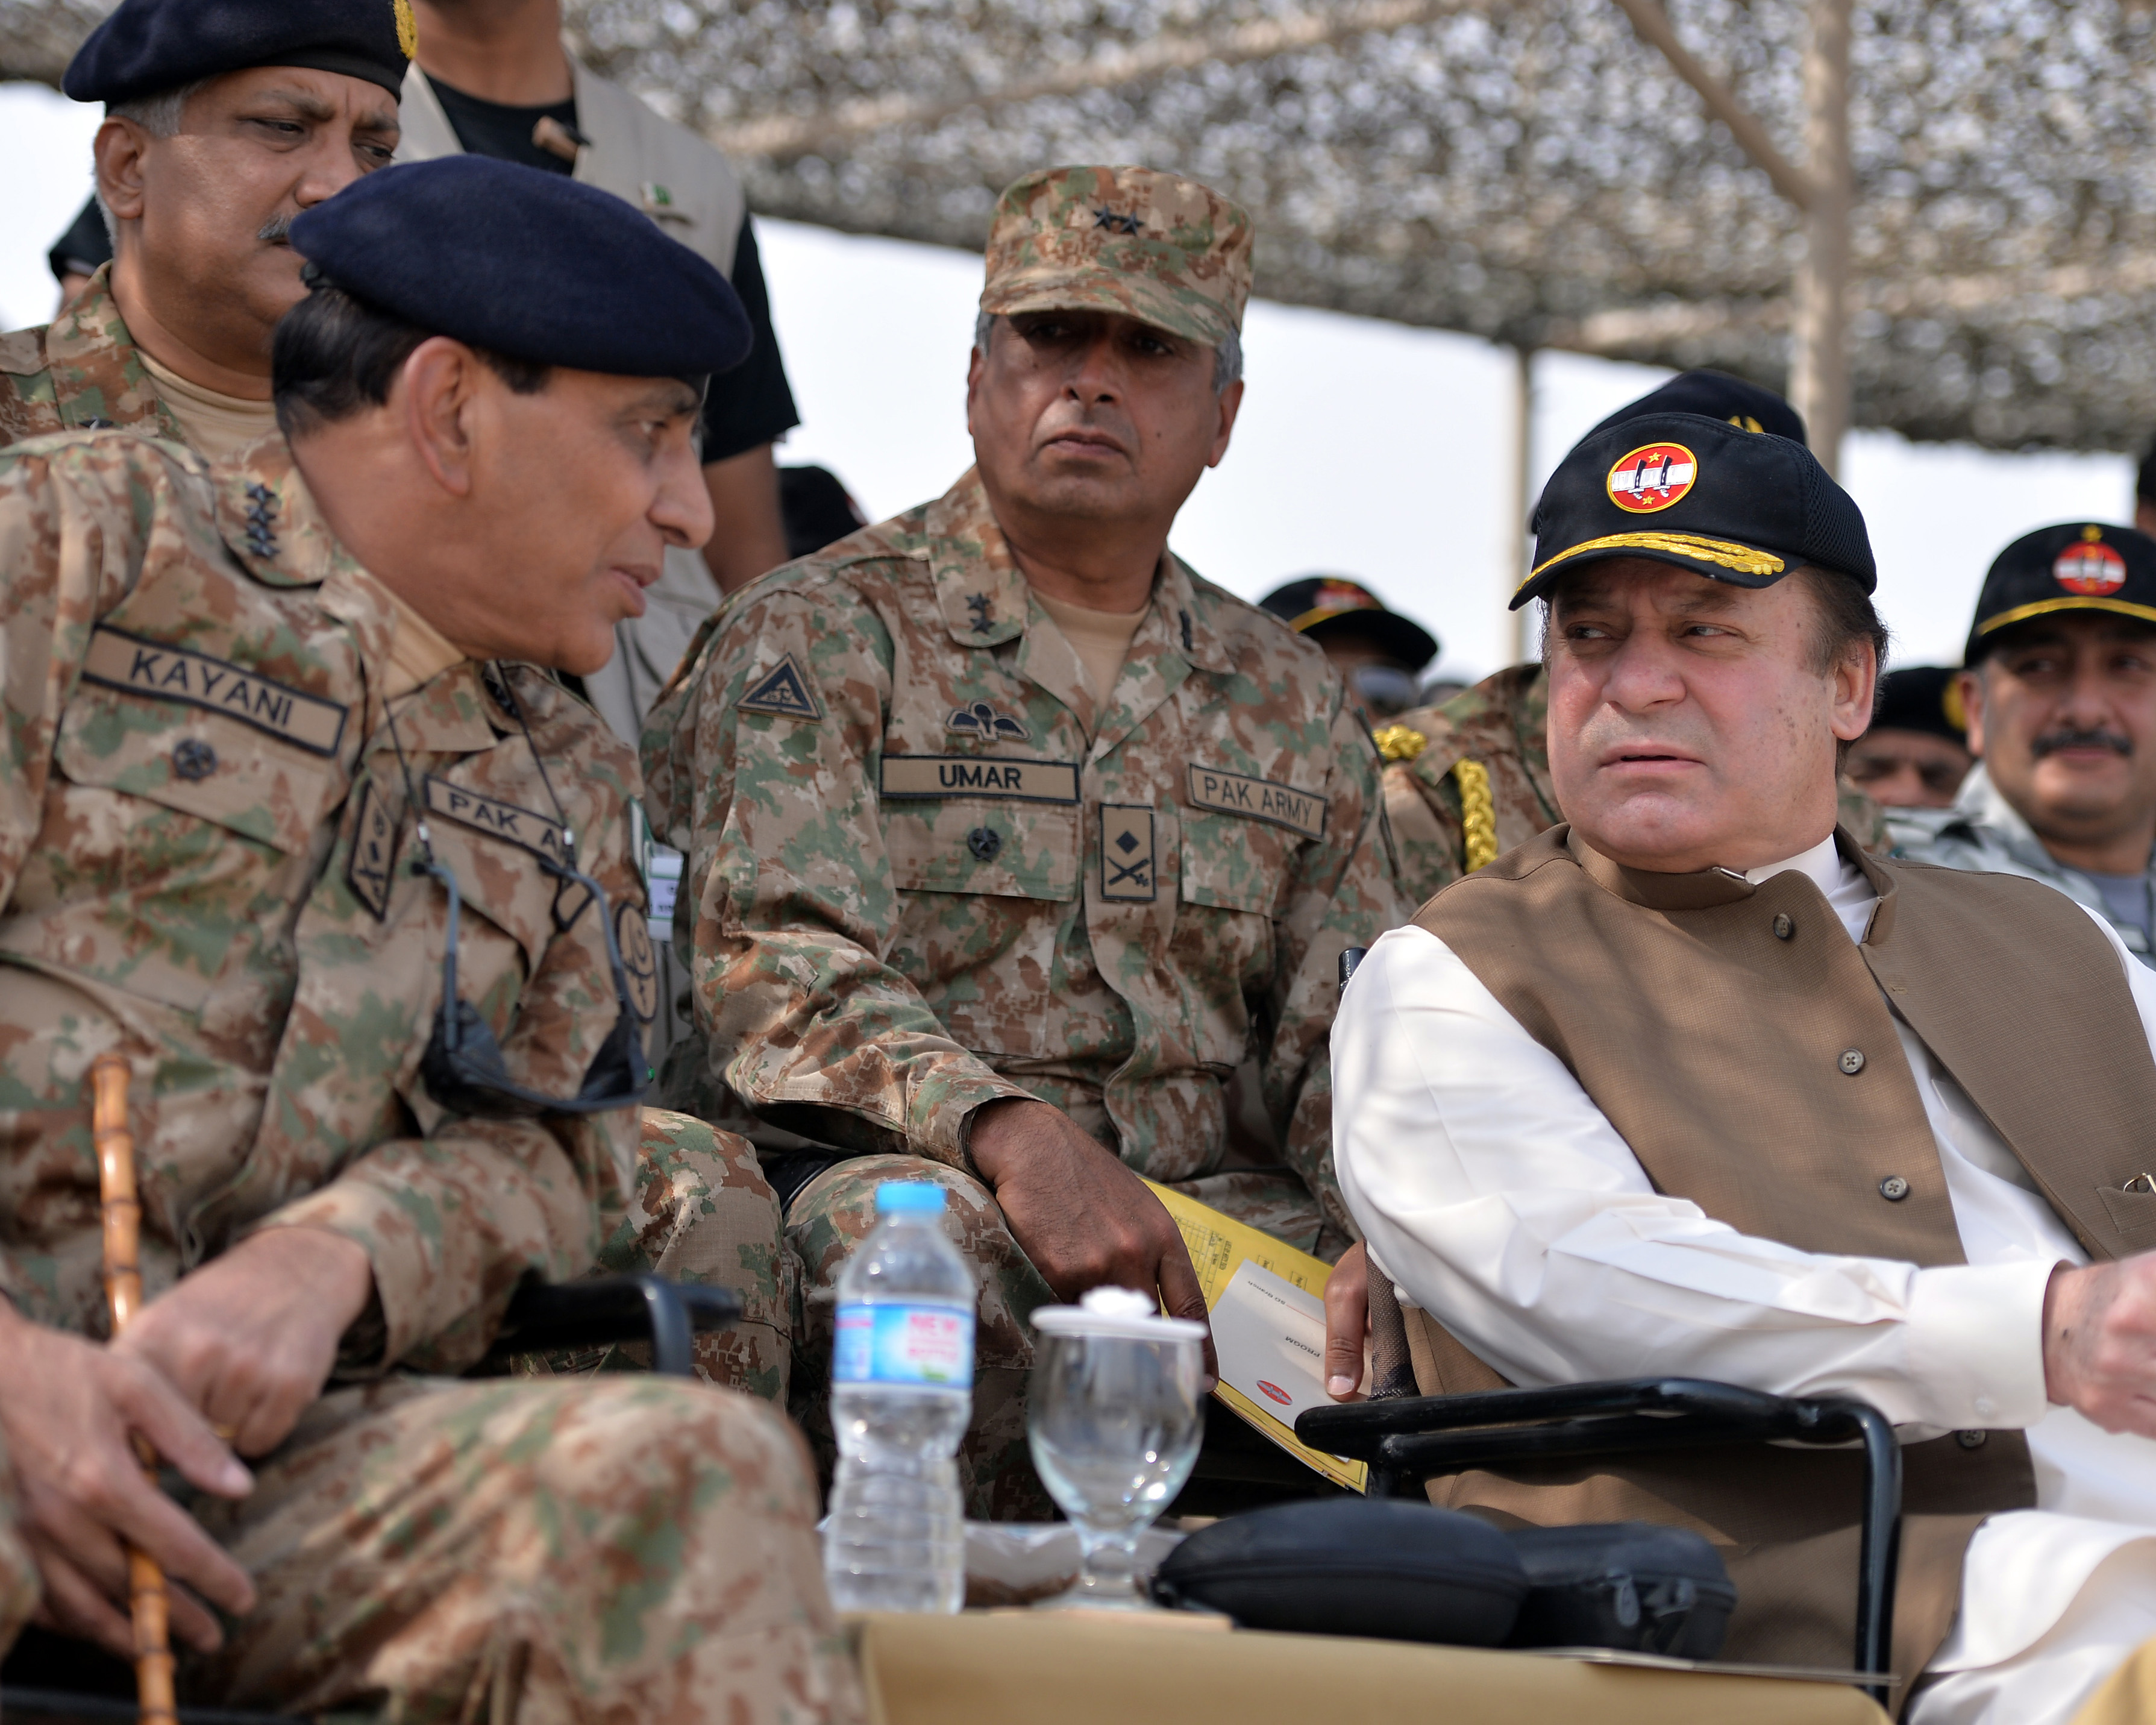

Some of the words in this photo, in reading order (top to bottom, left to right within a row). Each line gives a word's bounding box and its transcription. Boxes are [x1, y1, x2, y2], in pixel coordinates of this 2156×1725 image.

[130, 649, 293, 726] KAYANI
[939, 765, 1021, 790] UMAR
[449, 793, 519, 835] PAK
[1204, 776, 1253, 809] PAK
[1262, 788, 1312, 826] ARMY
[1285, 1335, 1321, 1358] PROGM
